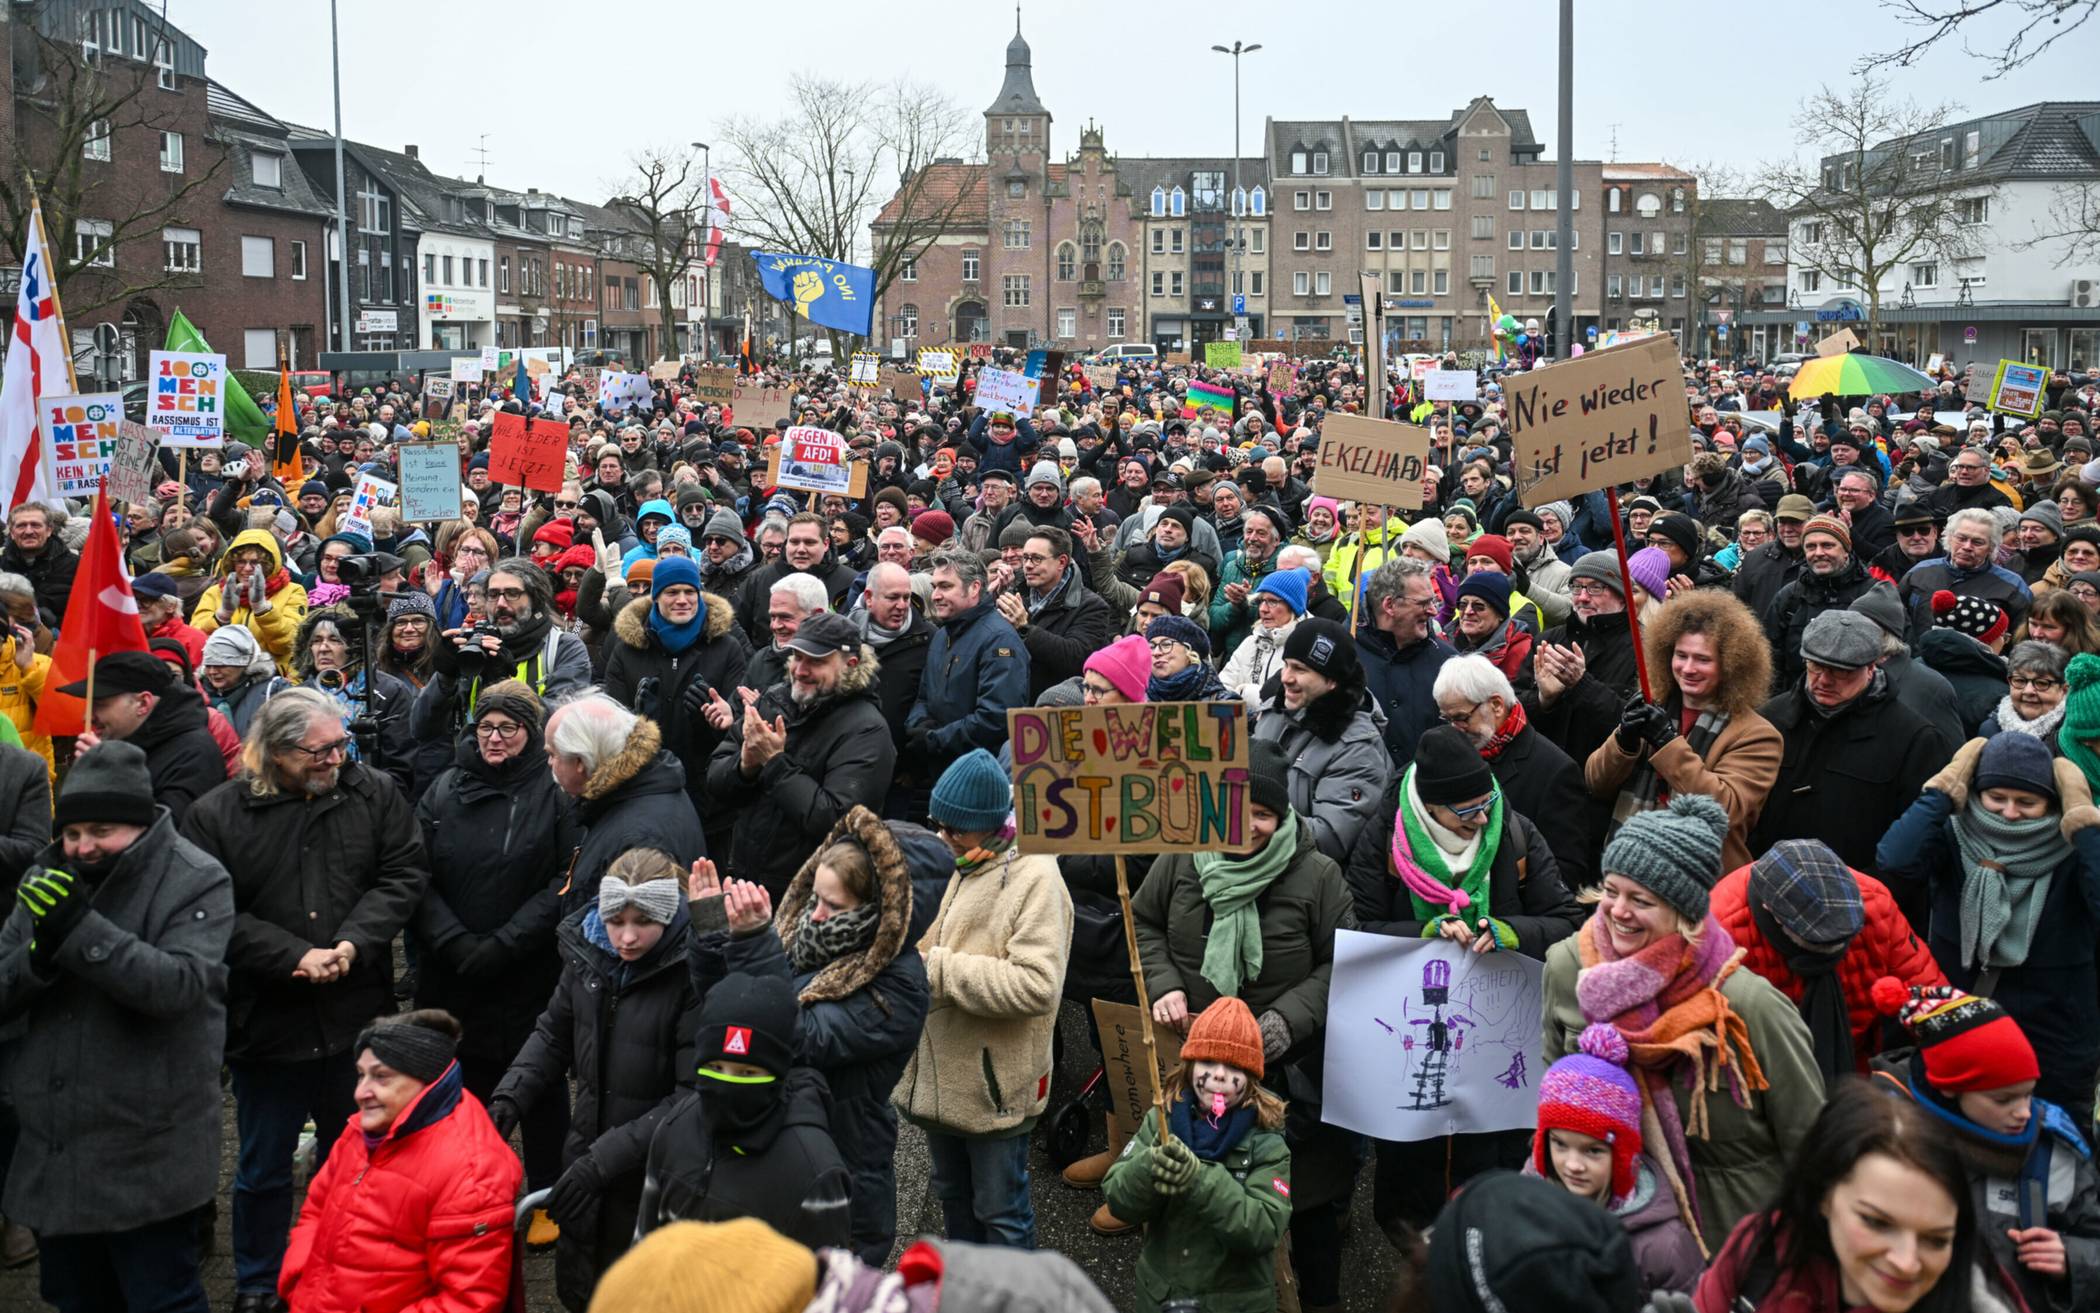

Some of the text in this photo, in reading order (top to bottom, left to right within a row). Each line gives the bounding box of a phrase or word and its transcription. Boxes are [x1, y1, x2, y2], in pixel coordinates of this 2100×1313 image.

[159, 360, 217, 377] 100%
[158, 377, 216, 395] MEN
[157, 395, 215, 412] SCH
[1515, 377, 1666, 433] Nie wieder
[51, 404, 115, 424] 100%
[152, 415, 219, 427] RASSISMUS IST
[52, 422, 118, 443] MEN
[516, 430, 560, 446] WIEDER
[789, 428, 828, 445] GEGEN
[56, 440, 117, 461] SCH
[516, 445, 537, 456] IST
[803, 446, 832, 462] AFD!
[56, 463, 112, 478] KEIN PLA
[115, 452, 139, 471] KEINE
[405, 458, 447, 468] ist keine
[1534, 445, 1563, 479] ist
[405, 484, 455, 493] sondern ein
[1014, 703, 1242, 765] DIE WELT
[1021, 768, 1249, 845] IST BUNT
[1459, 968, 1520, 997] FREIHEIT
[1111, 1023, 1143, 1122] somewhere
